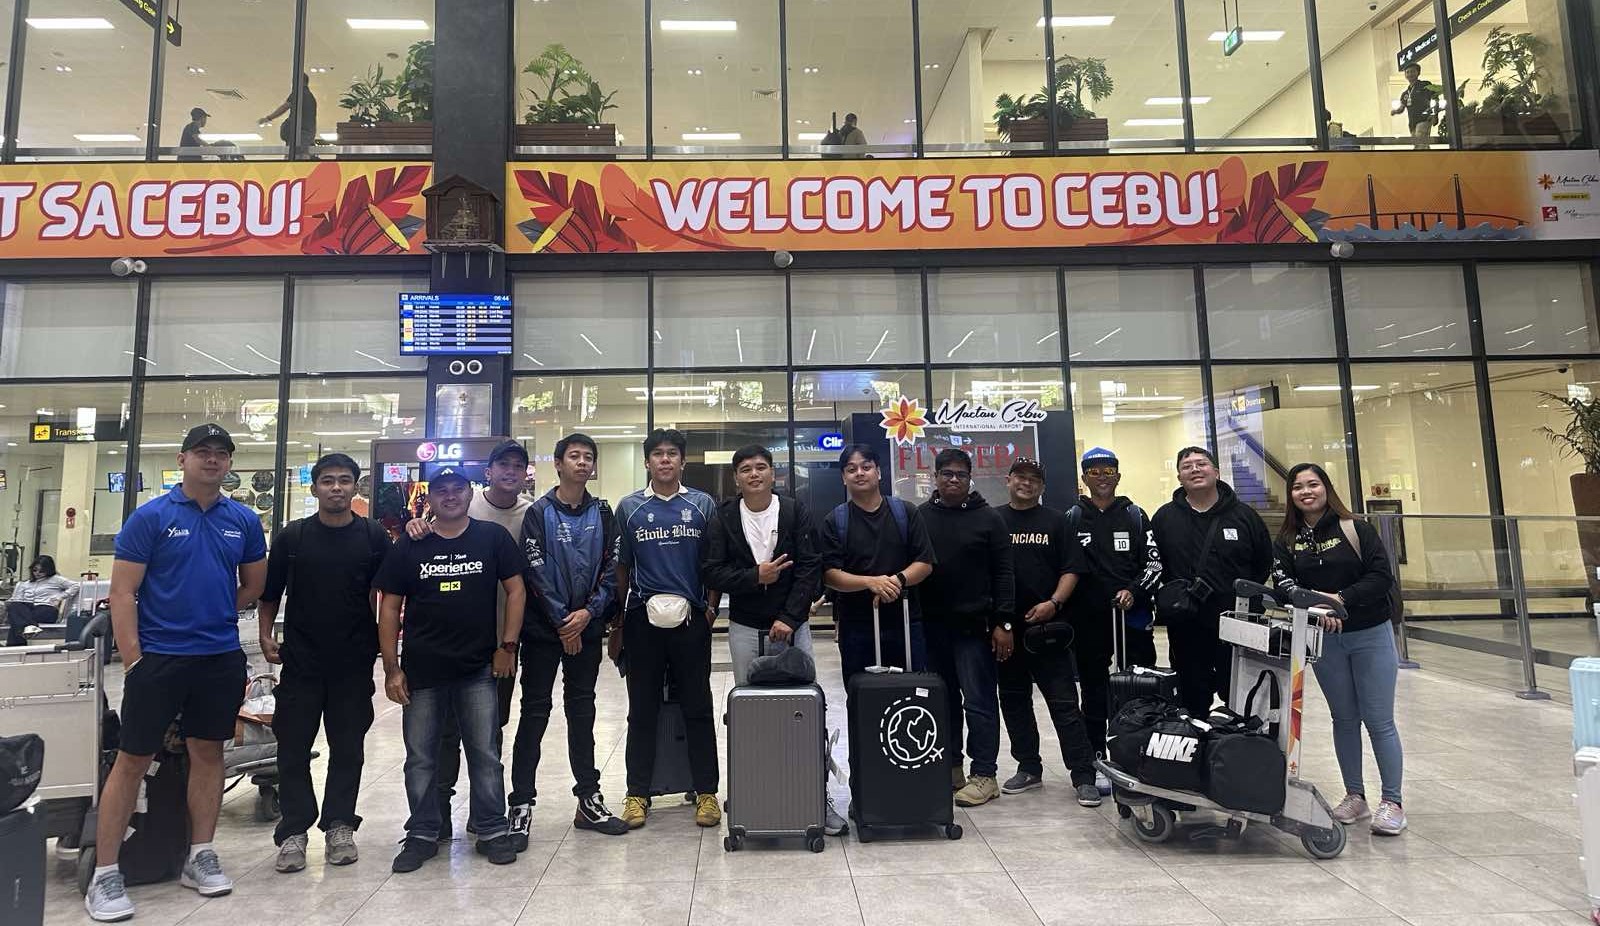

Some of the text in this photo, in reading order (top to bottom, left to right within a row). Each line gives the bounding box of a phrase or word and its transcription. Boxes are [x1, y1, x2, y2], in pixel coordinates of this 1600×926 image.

[0, 180, 305, 239] T SA CEBU!
[650, 169, 1221, 234] WELCOME TO CEBU!
[937, 401, 1045, 423] Mactan Cebu
[437, 443, 462, 459] LG
[635, 526, 670, 542] Étoile
[1009, 533, 1049, 545] NCIAGA
[1118, 540, 1127, 549] 10
[420, 561, 483, 576] Xperience
[1146, 732, 1199, 763] NIKE
